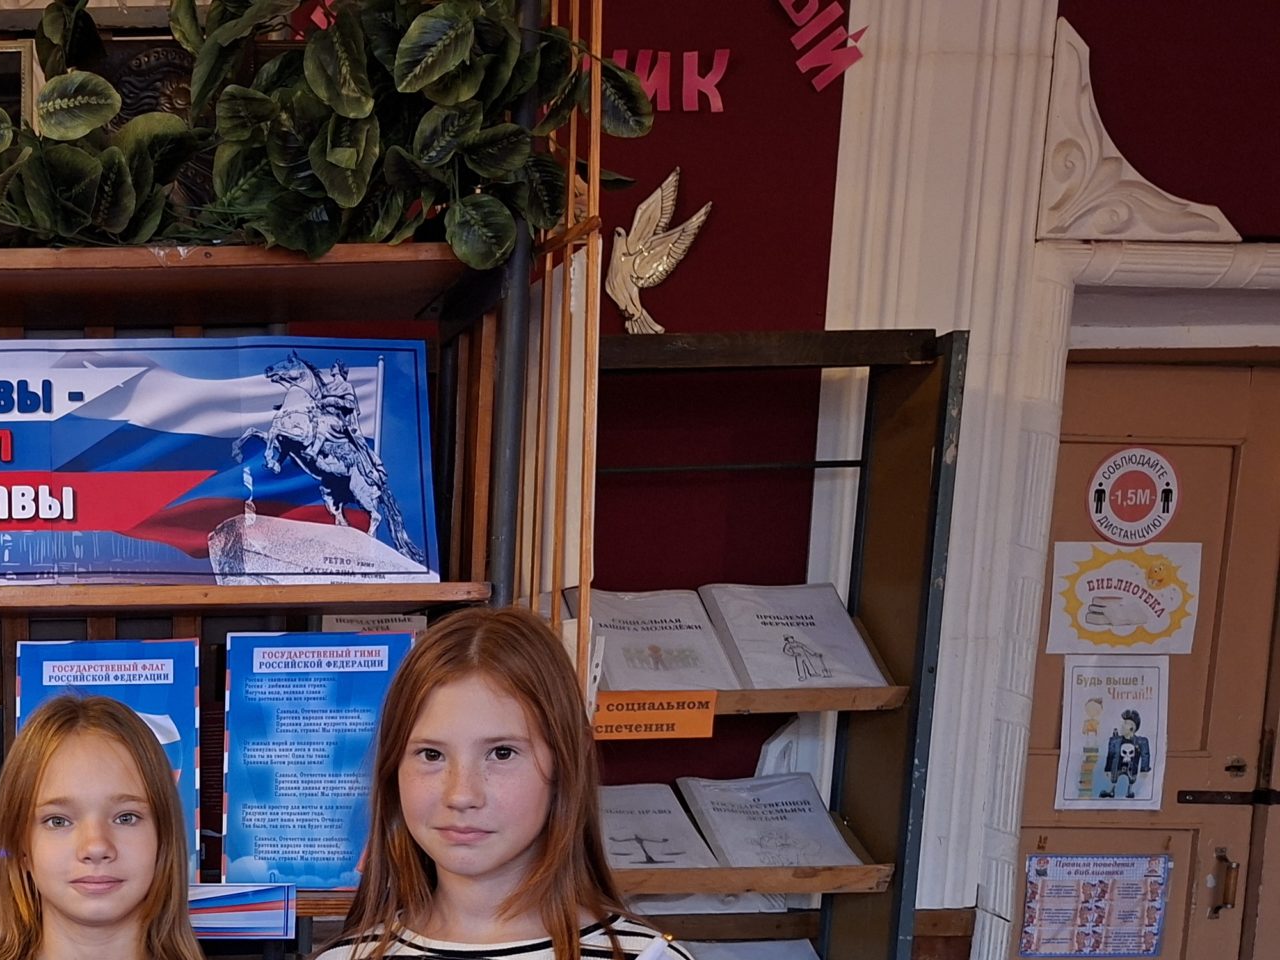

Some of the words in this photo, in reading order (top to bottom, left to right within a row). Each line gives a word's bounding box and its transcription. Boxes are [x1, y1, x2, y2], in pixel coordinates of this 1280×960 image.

[1101, 453, 1168, 481] СОБЛЮДАЙТЕ
[1096, 515, 1166, 540] ДИСТАНЦИЮ!
[1086, 577, 1165, 618] БИБЛИОТЕКА
[354, 649, 381, 658] ГИМН
[141, 663, 165, 671] ФЛАГ
[259, 659, 322, 669] РОССИЙСКОЙ
[325, 659, 384, 669] ФЕДЕРАЦИИ
[48, 673, 110, 683] РОССИЙСКОЙ
[113, 673, 169, 682] ФЕДЕРАЦИИ
[1076, 674, 1103, 687] Будь
[1106, 676, 1138, 685] выше
[606, 700, 710, 712] социальном
[595, 722, 676, 733] спечении
